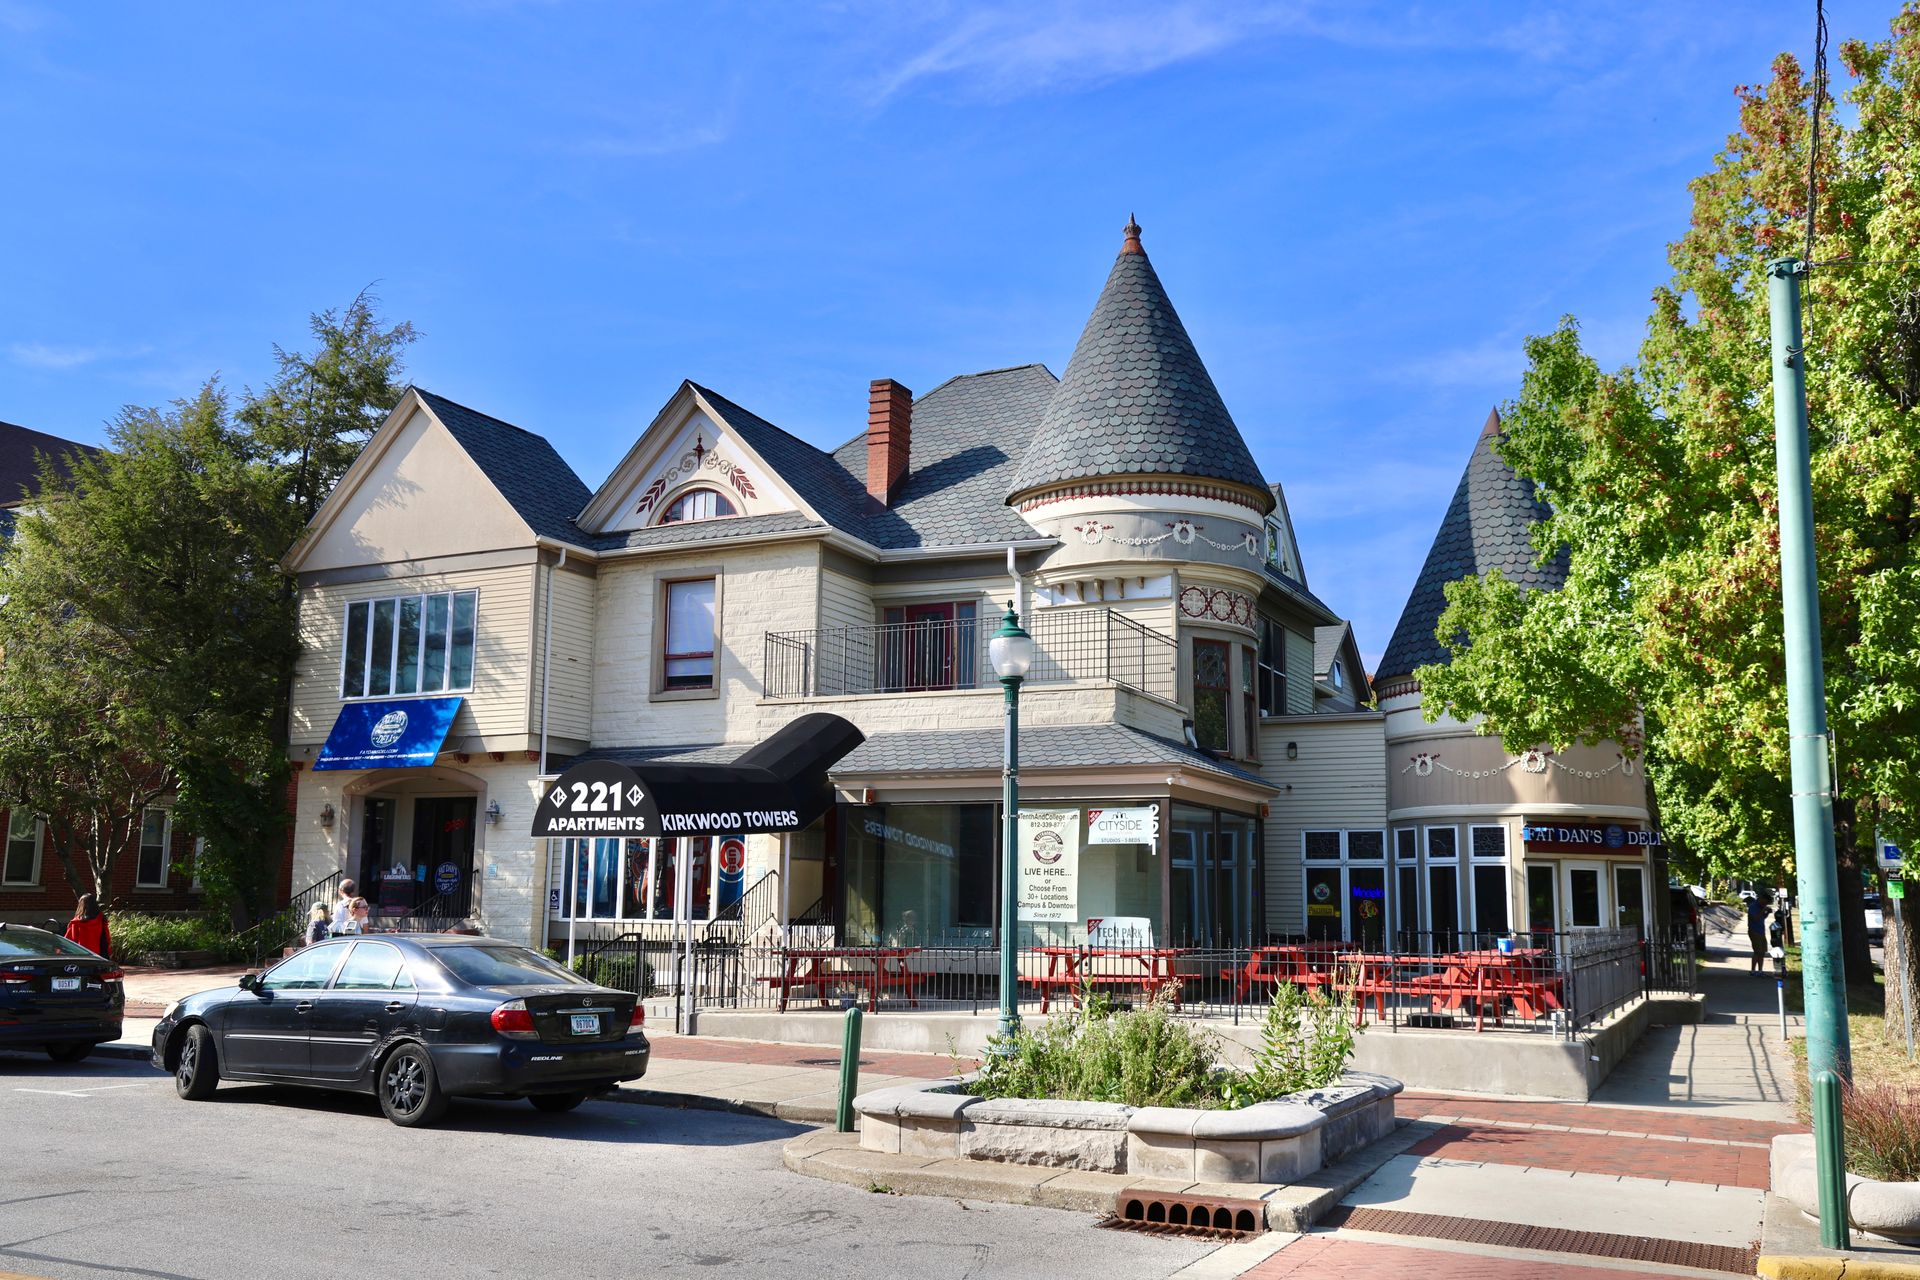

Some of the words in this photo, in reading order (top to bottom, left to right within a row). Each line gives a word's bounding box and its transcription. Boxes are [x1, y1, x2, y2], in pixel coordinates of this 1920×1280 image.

[571, 781, 623, 812] 221
[547, 816, 645, 831] APARTMENTS
[661, 813, 741, 832] KIRKWOOD
[743, 810, 799, 828] TOWERS
[1098, 819, 1142, 831] CITYSIDE
[1528, 827, 1555, 841] FAT
[1558, 827, 1603, 844] DAN'S
[1627, 831, 1662, 846] DELI
[1024, 867, 1042, 876] LIVE
[1043, 868, 1072, 877] HERE...
[1028, 884, 1051, 892] Choose
[1051, 884, 1067, 892] From
[1017, 901, 1041, 909] Campus
[1097, 927, 1119, 938] TECH
[1121, 927, 1143, 938] PARK
